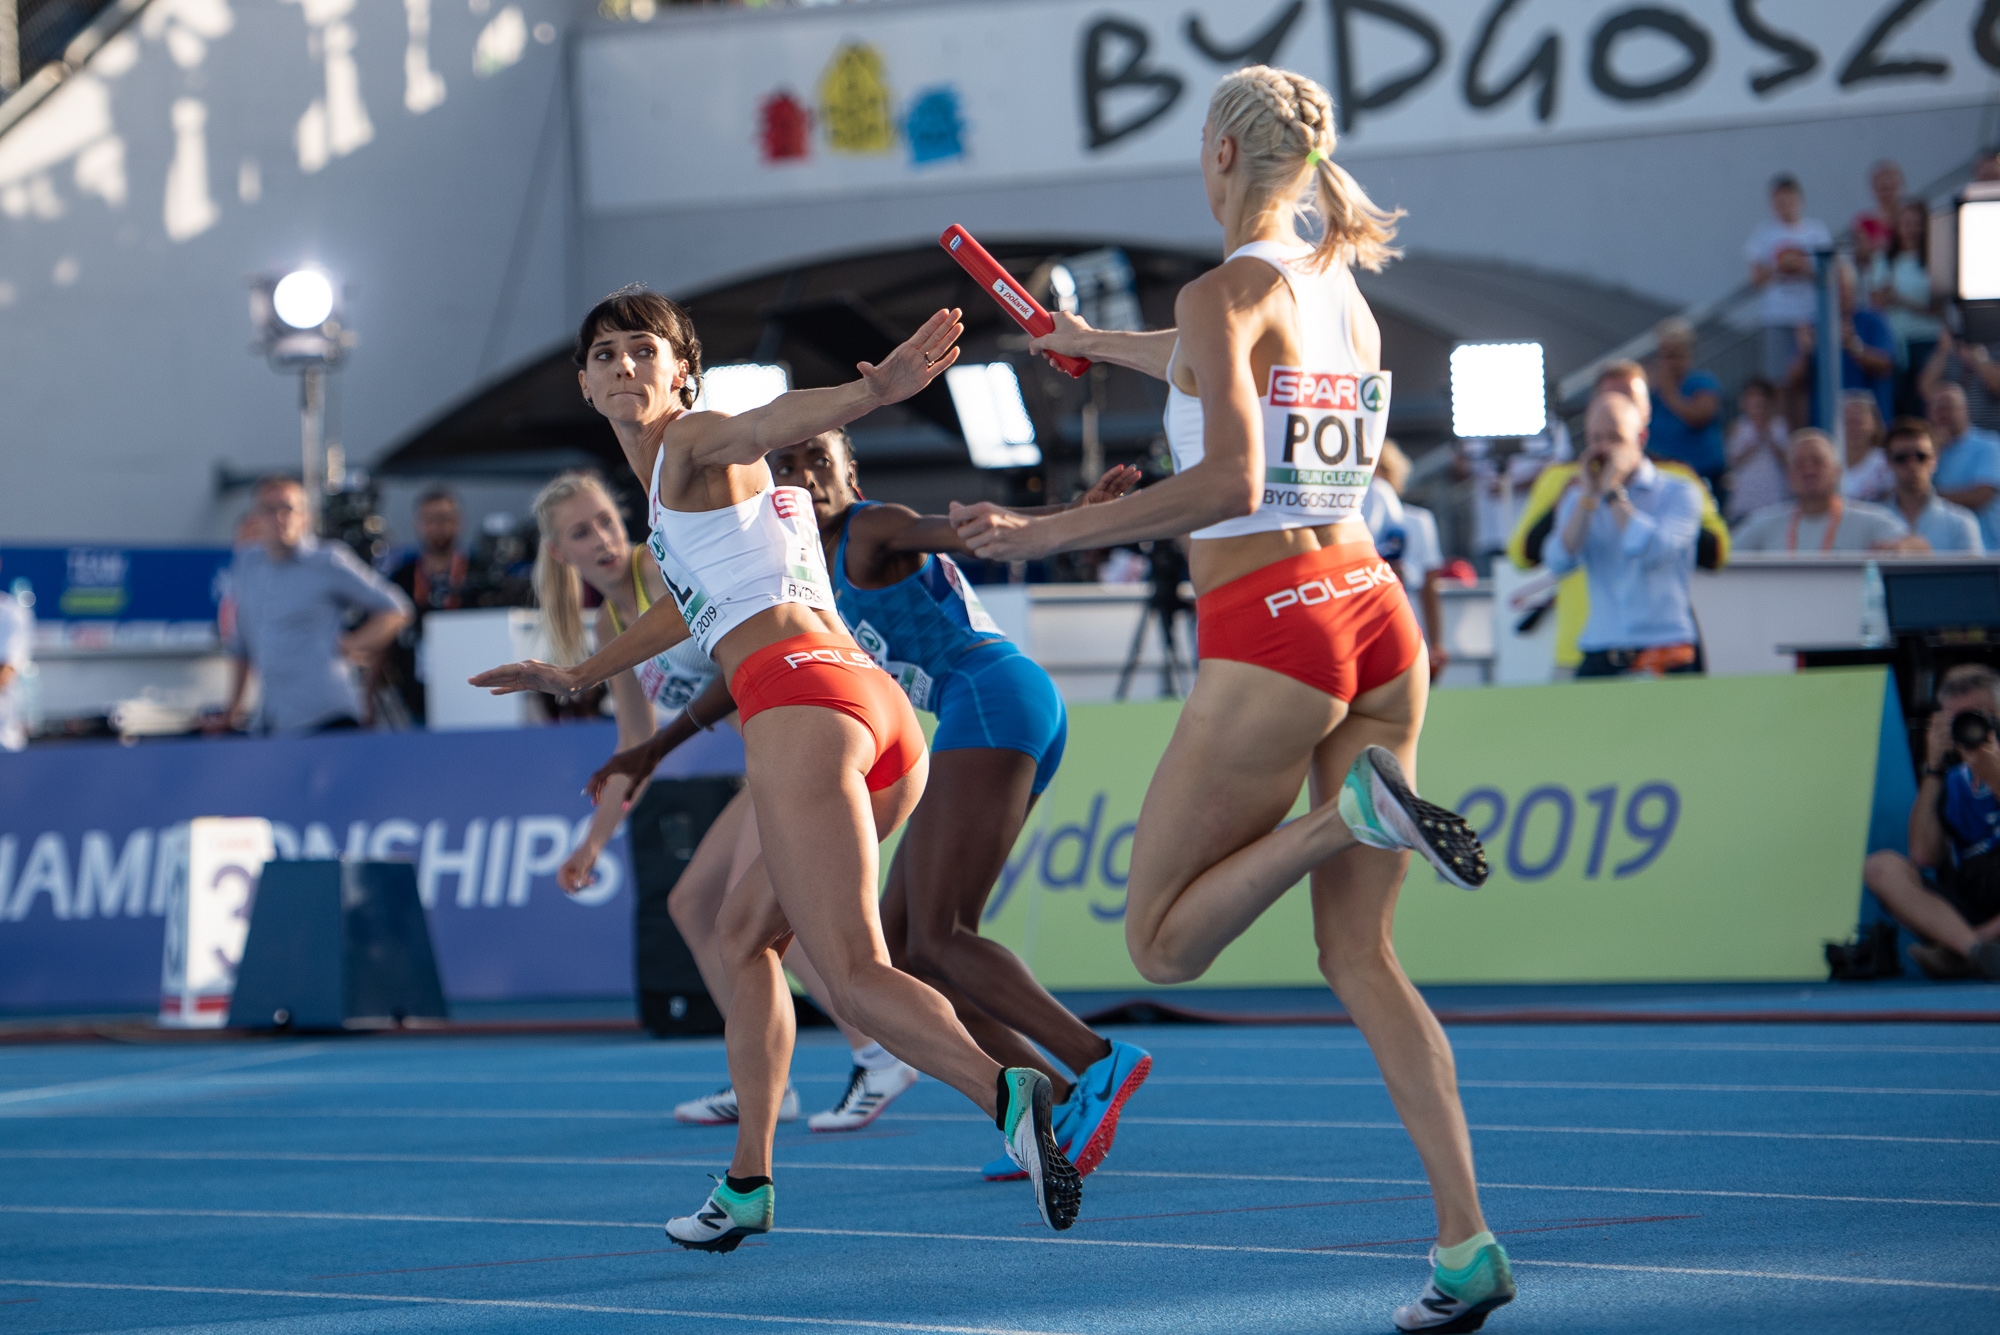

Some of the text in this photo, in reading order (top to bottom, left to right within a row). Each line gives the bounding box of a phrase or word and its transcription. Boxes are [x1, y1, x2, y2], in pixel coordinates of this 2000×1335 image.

[1003, 290, 1031, 316] polanik
[1274, 375, 1356, 407] SPAR
[1282, 413, 1374, 466] POL
[1290, 470, 1365, 485] I RUN CLEAN
[1263, 489, 1357, 509] BYDGOSZCZ
[696, 605, 718, 635] 2019
[1436, 780, 1682, 883] 2019
